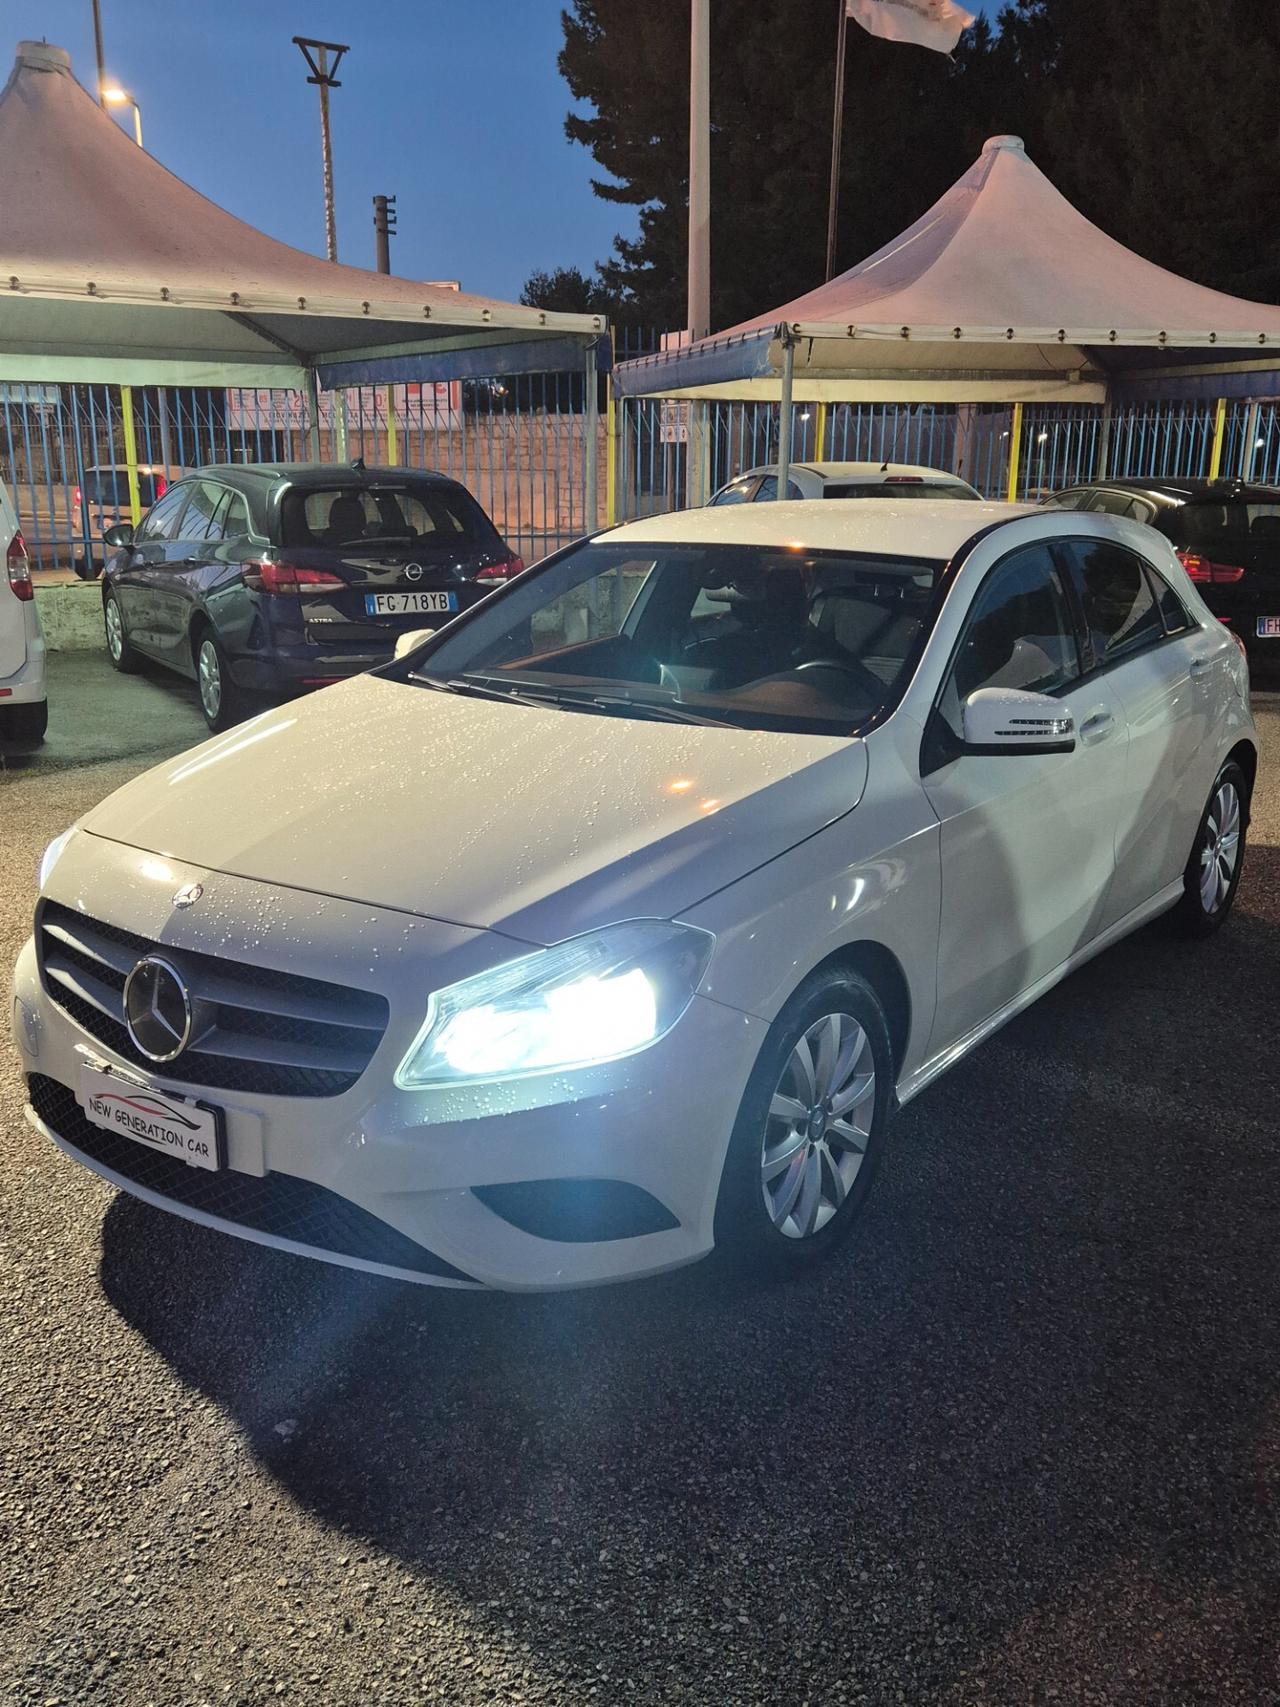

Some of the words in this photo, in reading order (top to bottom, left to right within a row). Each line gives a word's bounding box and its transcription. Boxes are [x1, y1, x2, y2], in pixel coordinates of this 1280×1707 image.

[89, 1097, 112, 1118] NEW
[115, 1109, 184, 1148] GENERATION
[187, 1138, 209, 1157] CAR
